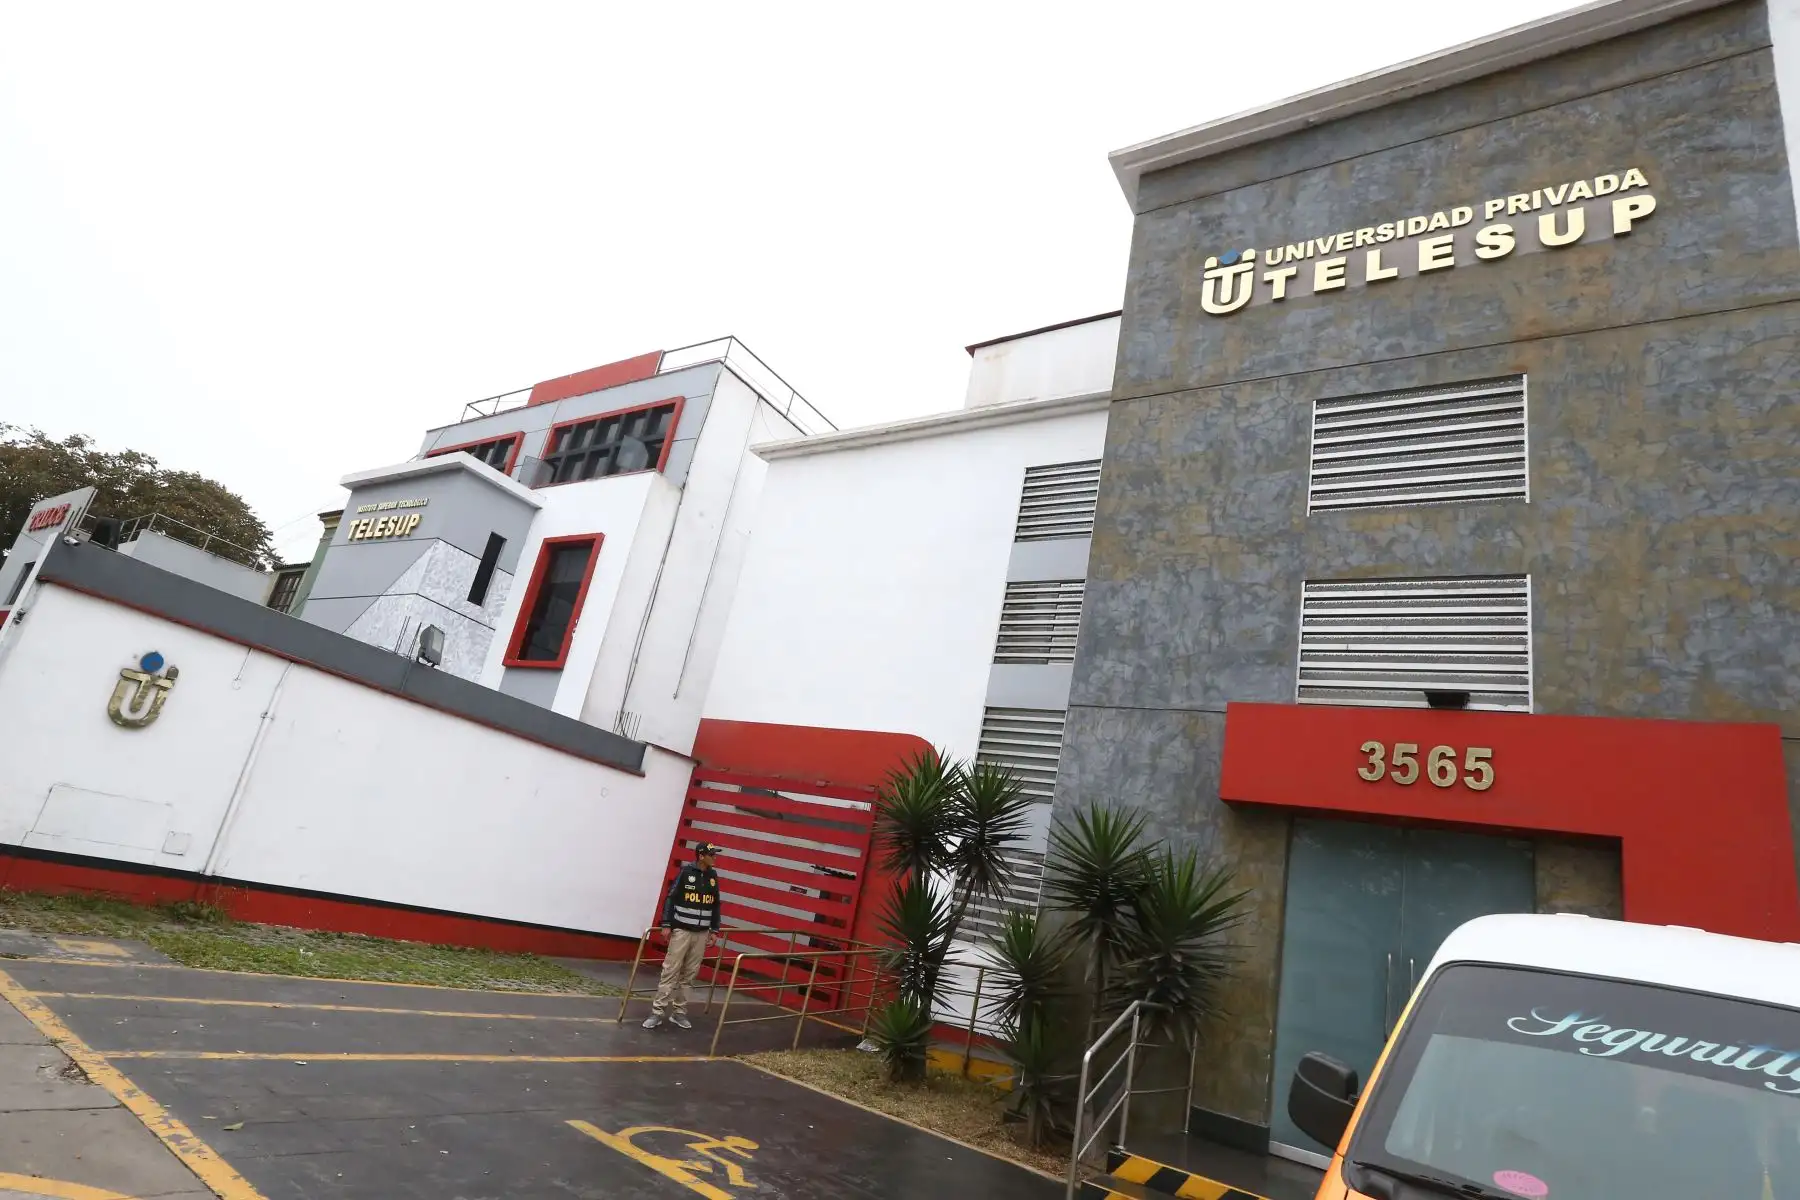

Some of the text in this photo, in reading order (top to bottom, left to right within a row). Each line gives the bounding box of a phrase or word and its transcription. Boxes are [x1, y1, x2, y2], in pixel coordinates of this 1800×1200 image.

[1263, 194, 1658, 302] TELESUP
[1265, 167, 1649, 267] UNIVERSIDAD PRIVADA
[347, 513, 422, 541] TELESUP
[1357, 741, 1495, 791] 3565
